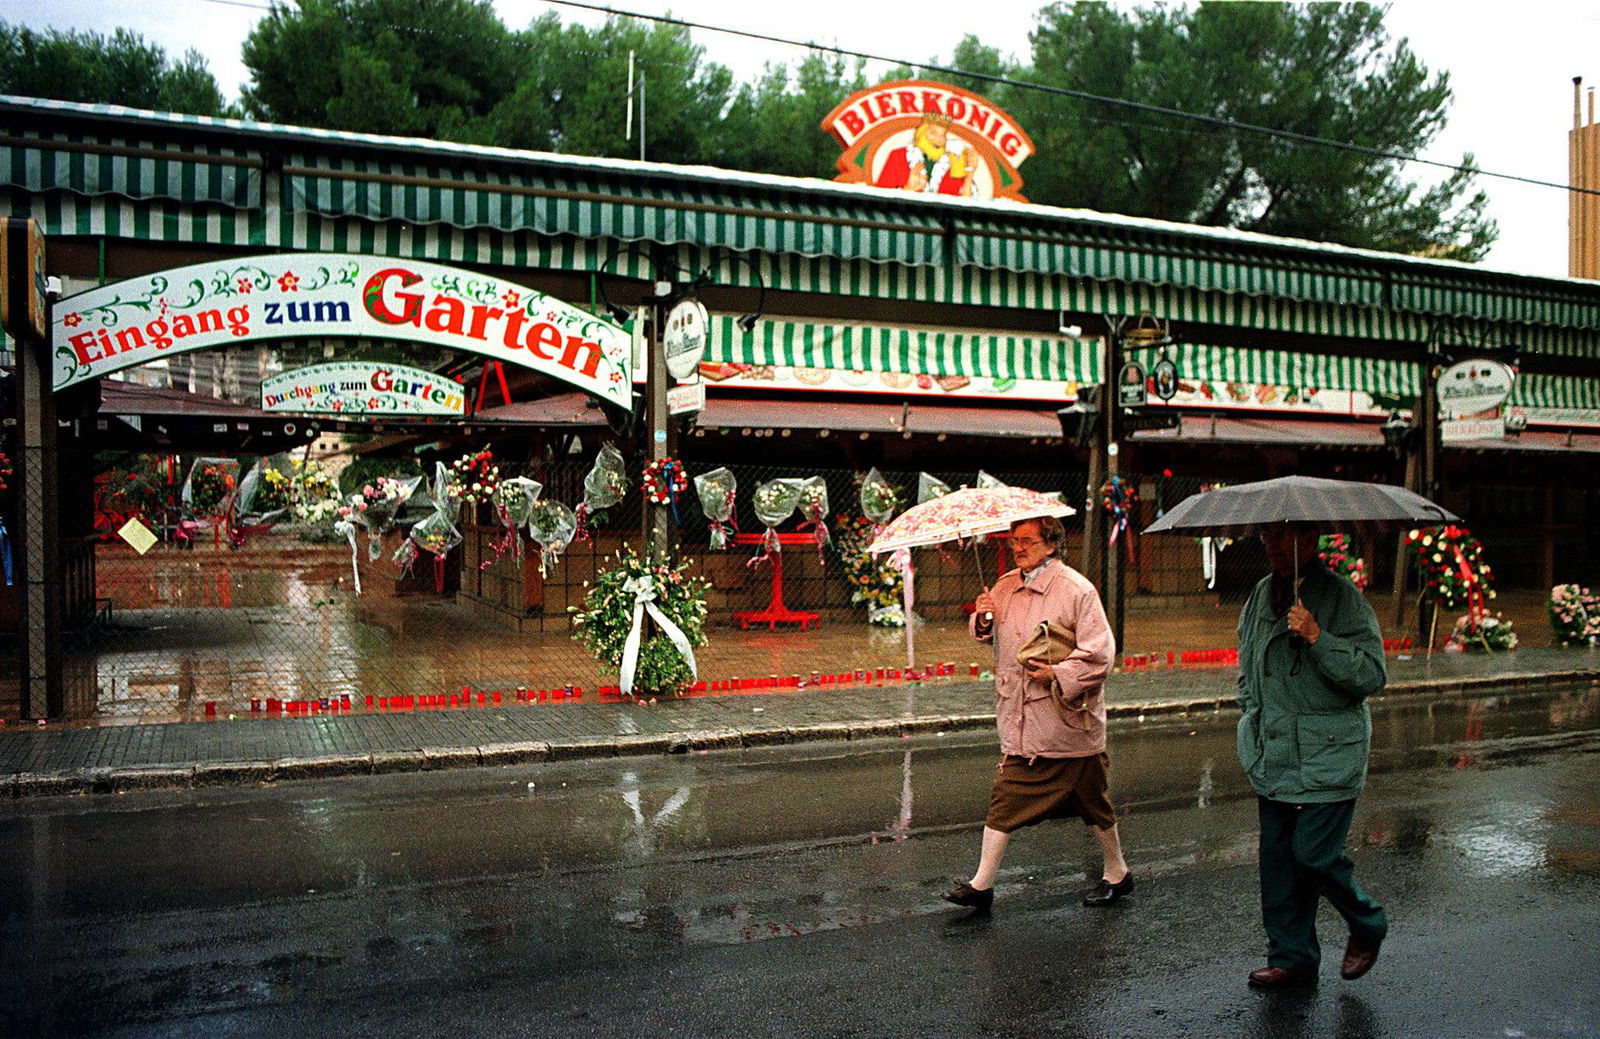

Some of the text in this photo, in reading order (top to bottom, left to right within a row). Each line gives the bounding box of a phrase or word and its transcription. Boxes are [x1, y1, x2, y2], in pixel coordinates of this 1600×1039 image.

[68, 304, 250, 367] Eingang
[264, 298, 351, 325] zum
[362, 268, 603, 380] Garten
[265, 369, 464, 412] Durchgang zum Garten
